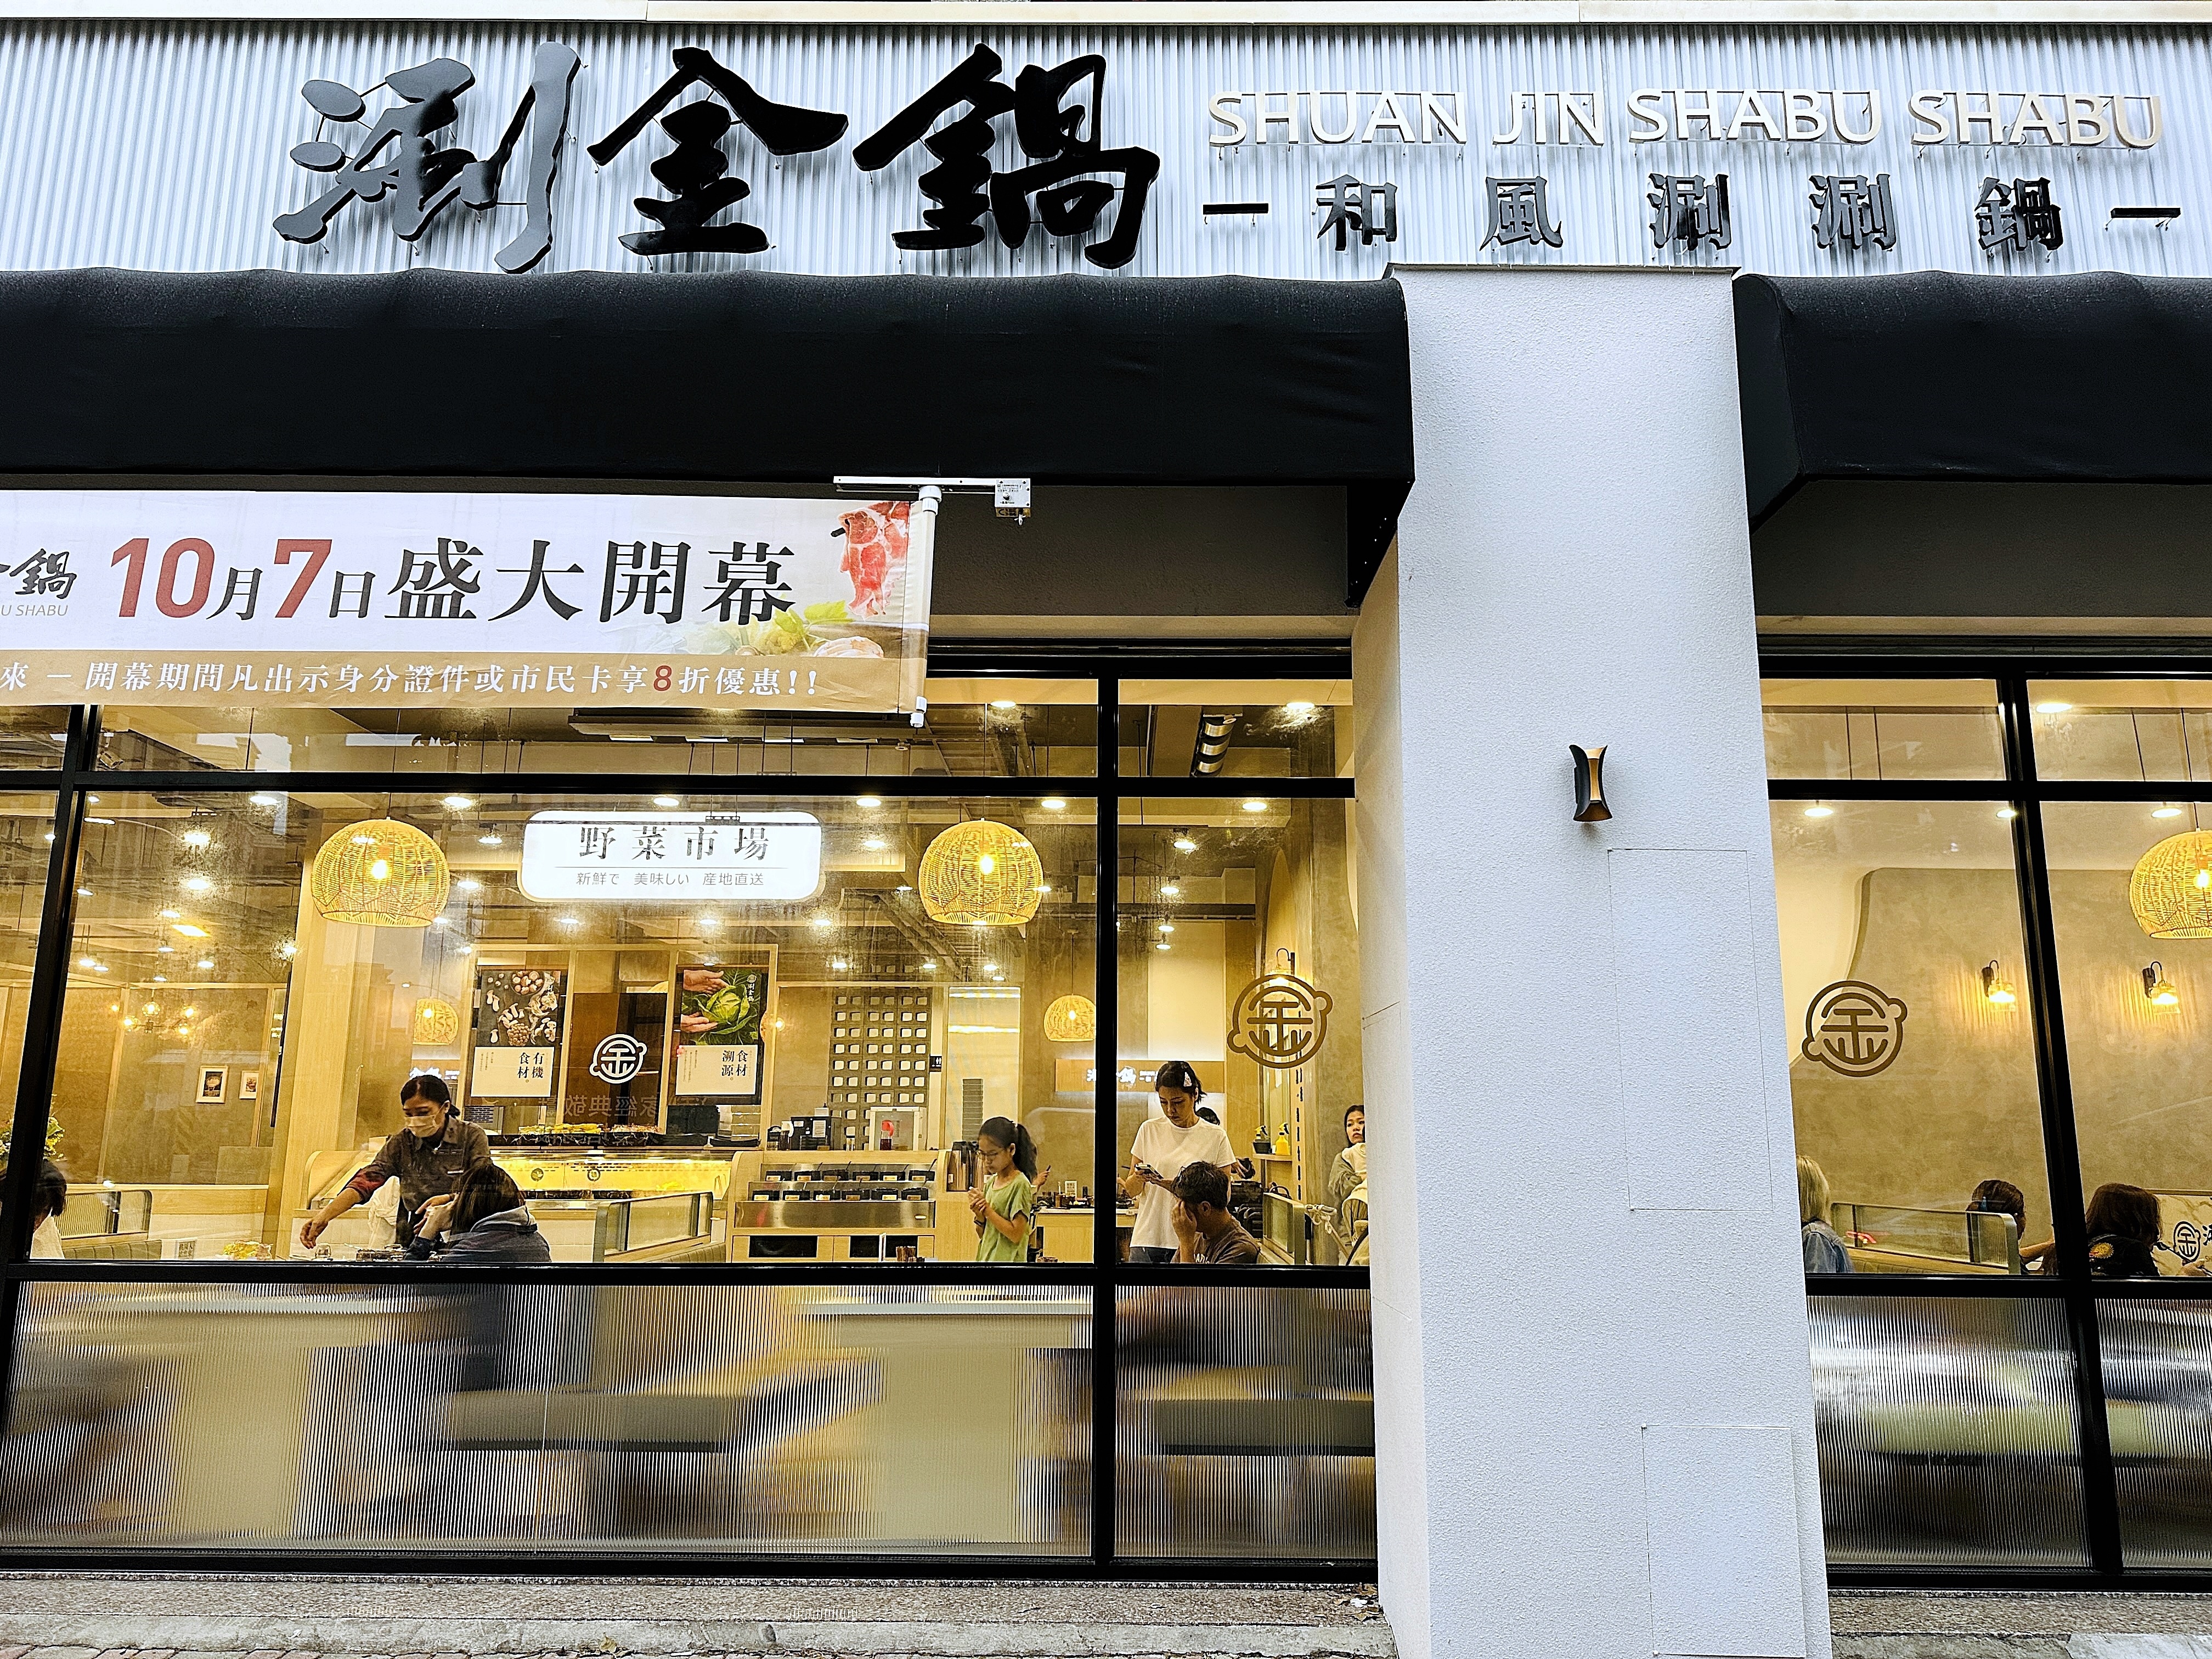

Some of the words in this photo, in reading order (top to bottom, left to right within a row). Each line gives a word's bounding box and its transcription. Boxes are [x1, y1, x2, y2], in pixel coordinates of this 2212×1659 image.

[1208, 91, 1466, 145] SHUAN
[1493, 91, 1605, 146] JIN
[1628, 88, 1882, 143] SHABU
[1909, 91, 2160, 149] SHABU
[273, 42, 1161, 274] 涮金鍋
[0, 548, 77, 599] 鍋
[15, 605, 69, 616] SHABU
[579, 826, 769, 860] 野菜市場
[517, 1052, 531, 1078] 食材
[736, 1050, 748, 1076] 食材
